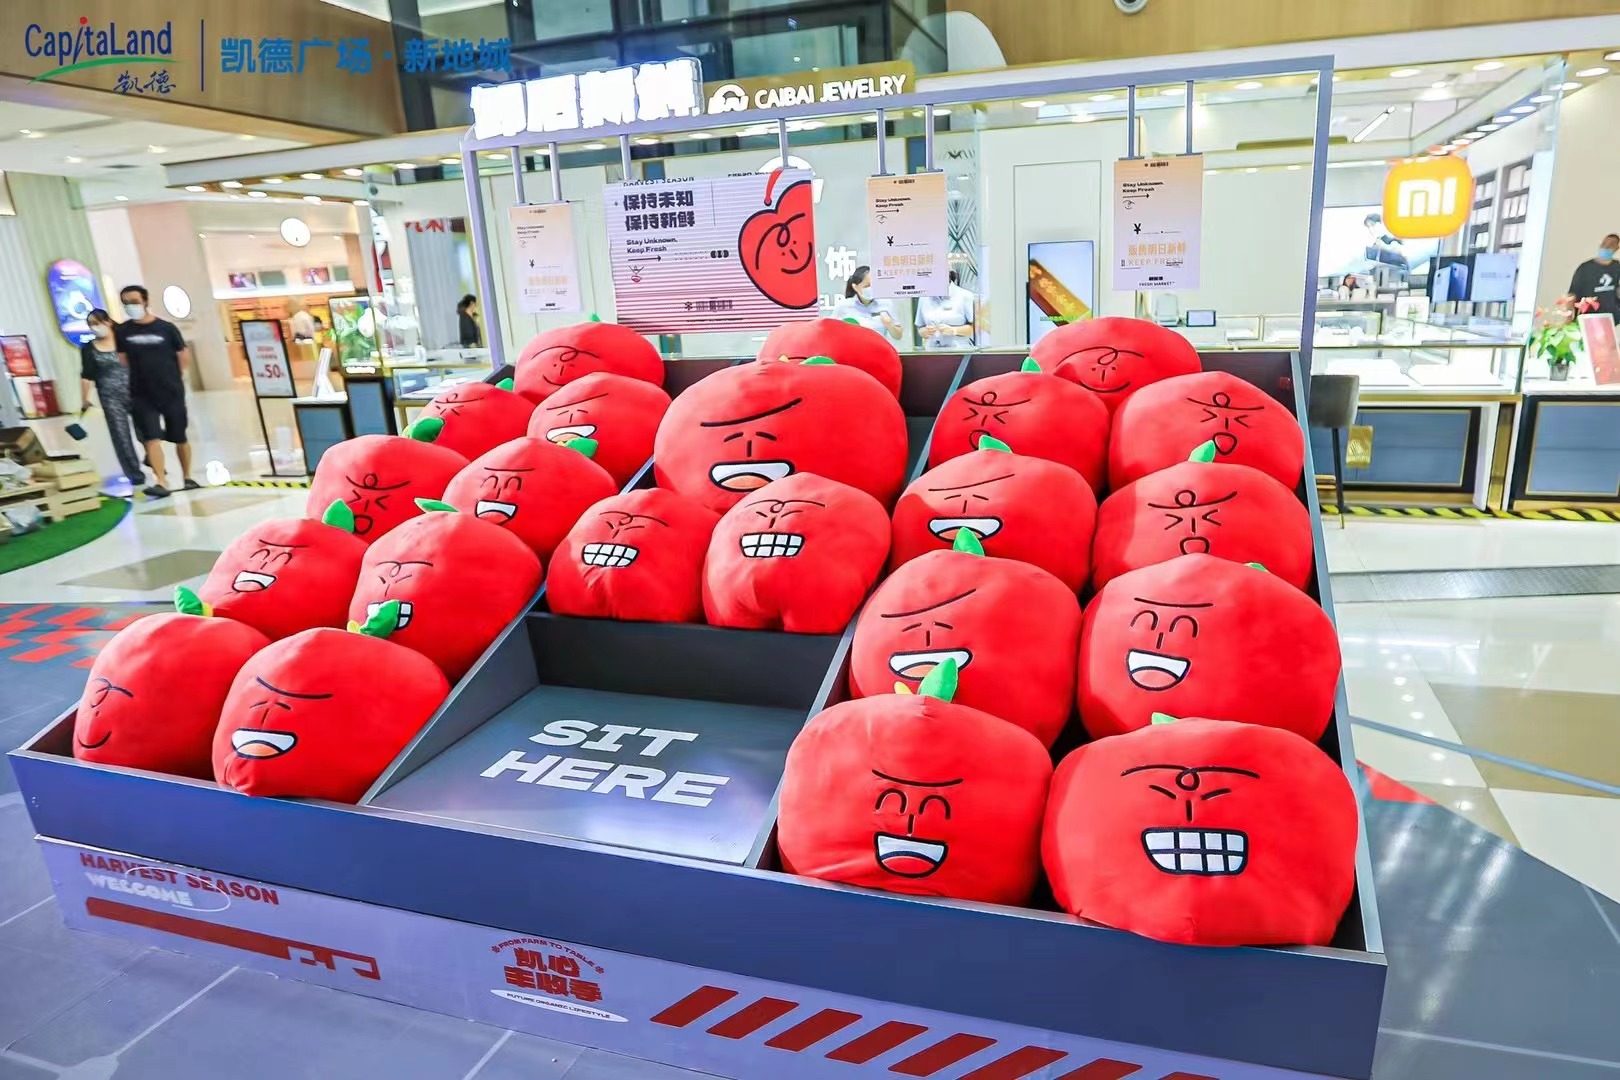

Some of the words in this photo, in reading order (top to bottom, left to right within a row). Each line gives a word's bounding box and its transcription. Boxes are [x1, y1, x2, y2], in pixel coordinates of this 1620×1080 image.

[754, 84, 815, 110] CAIBAI
[819, 74, 907, 103] JEWELRY
[623, 190, 694, 211] 保持未知
[625, 210, 696, 232] 保持新鲜
[529, 719, 699, 757] SIT
[480, 750, 731, 807] HERE
[80, 852, 177, 884] HARVEST
[186, 872, 280, 905] SEASON
[85, 872, 193, 907] WELCOME
[499, 938, 521, 950] FROM
[521, 938, 547, 946] FARM
[549, 941, 563, 949] TO
[563, 946, 595, 968] TABLE
[506, 992, 534, 1003] FUTURE
[535, 999, 568, 1010] ORGANIC
[568, 1006, 610, 1019] LIFESTYLE
